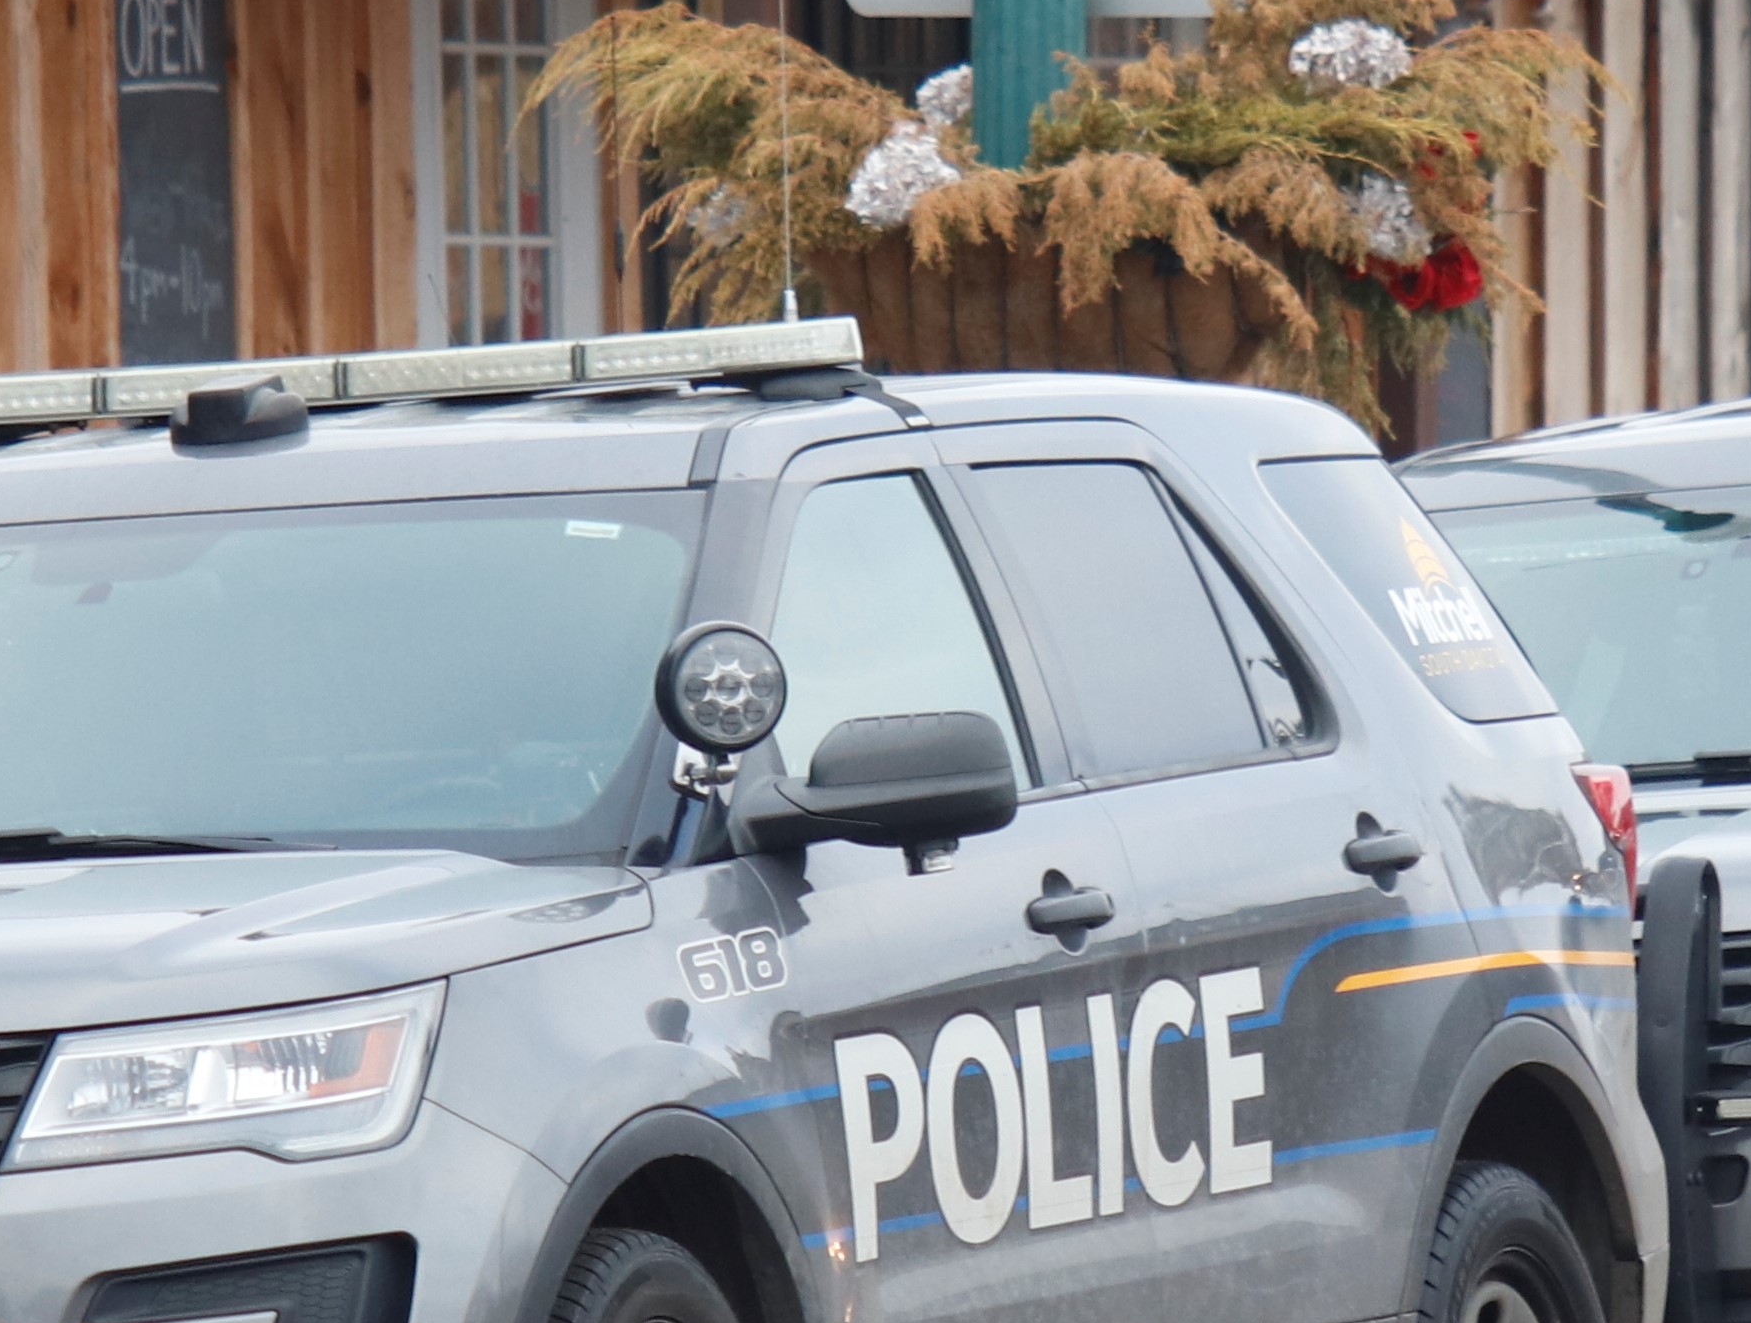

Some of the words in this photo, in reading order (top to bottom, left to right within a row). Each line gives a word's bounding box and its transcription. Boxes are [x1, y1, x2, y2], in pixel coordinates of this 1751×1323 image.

[1389, 585, 1494, 646] Mitchell
[676, 926, 787, 1003] 618
[834, 966, 1273, 1264] POLICE
